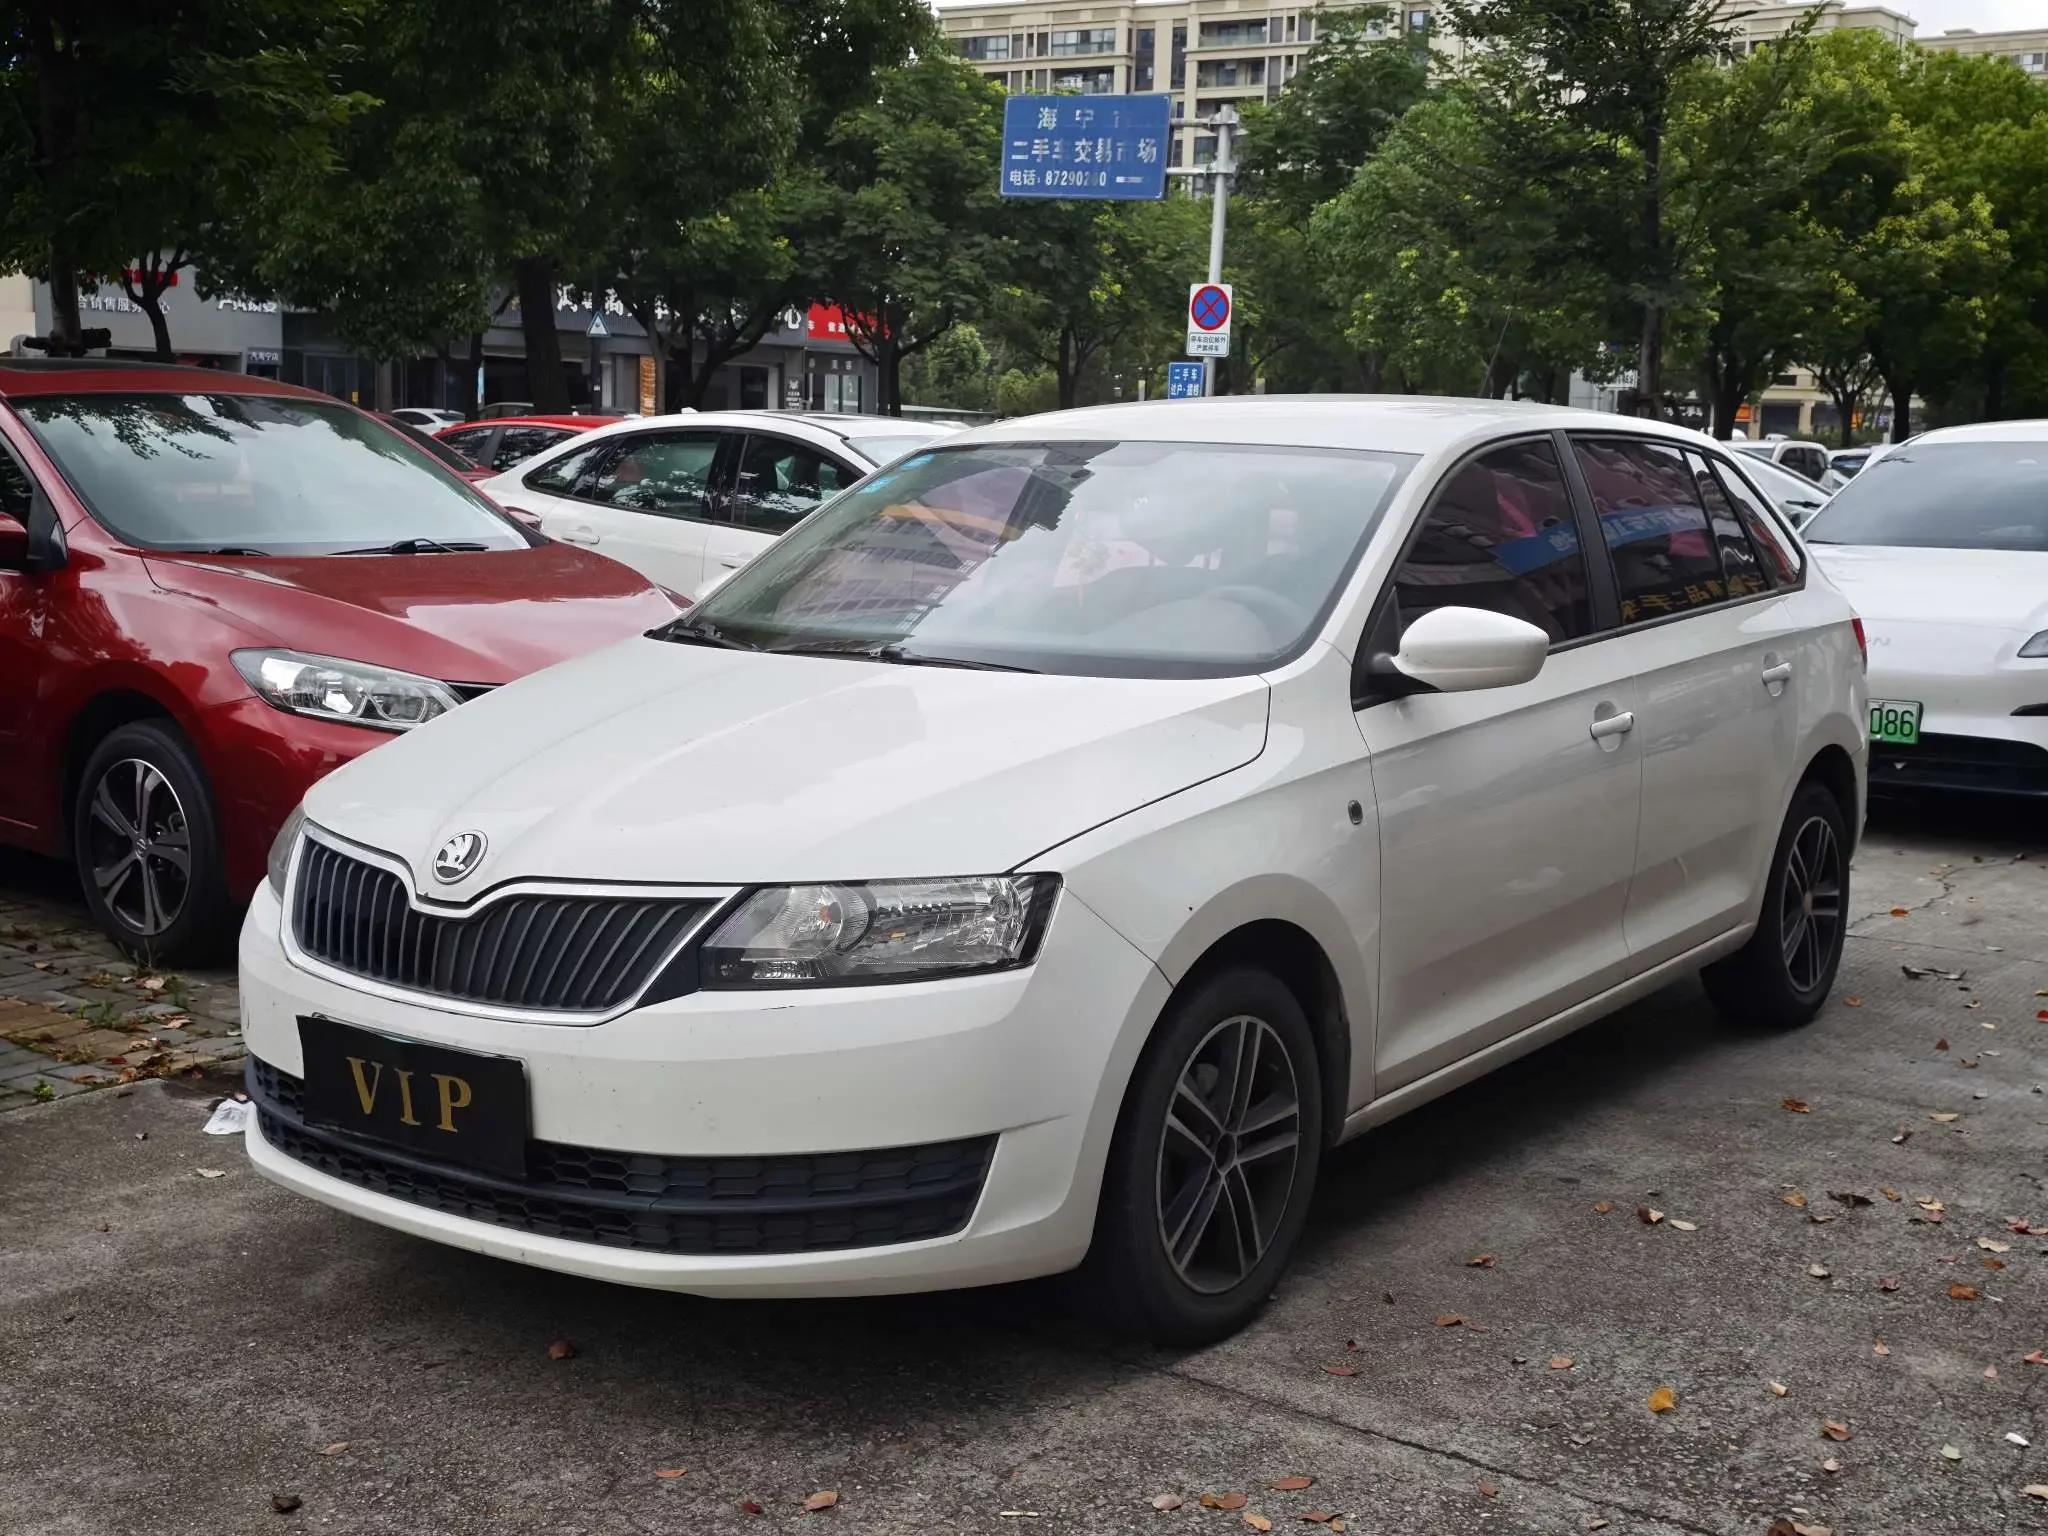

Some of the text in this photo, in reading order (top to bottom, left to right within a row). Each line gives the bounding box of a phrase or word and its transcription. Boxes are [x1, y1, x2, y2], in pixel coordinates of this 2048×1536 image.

[1173, 367, 1198, 382] 二手车
[1869, 707, 1915, 738] 086
[346, 1056, 473, 1134] VIP
